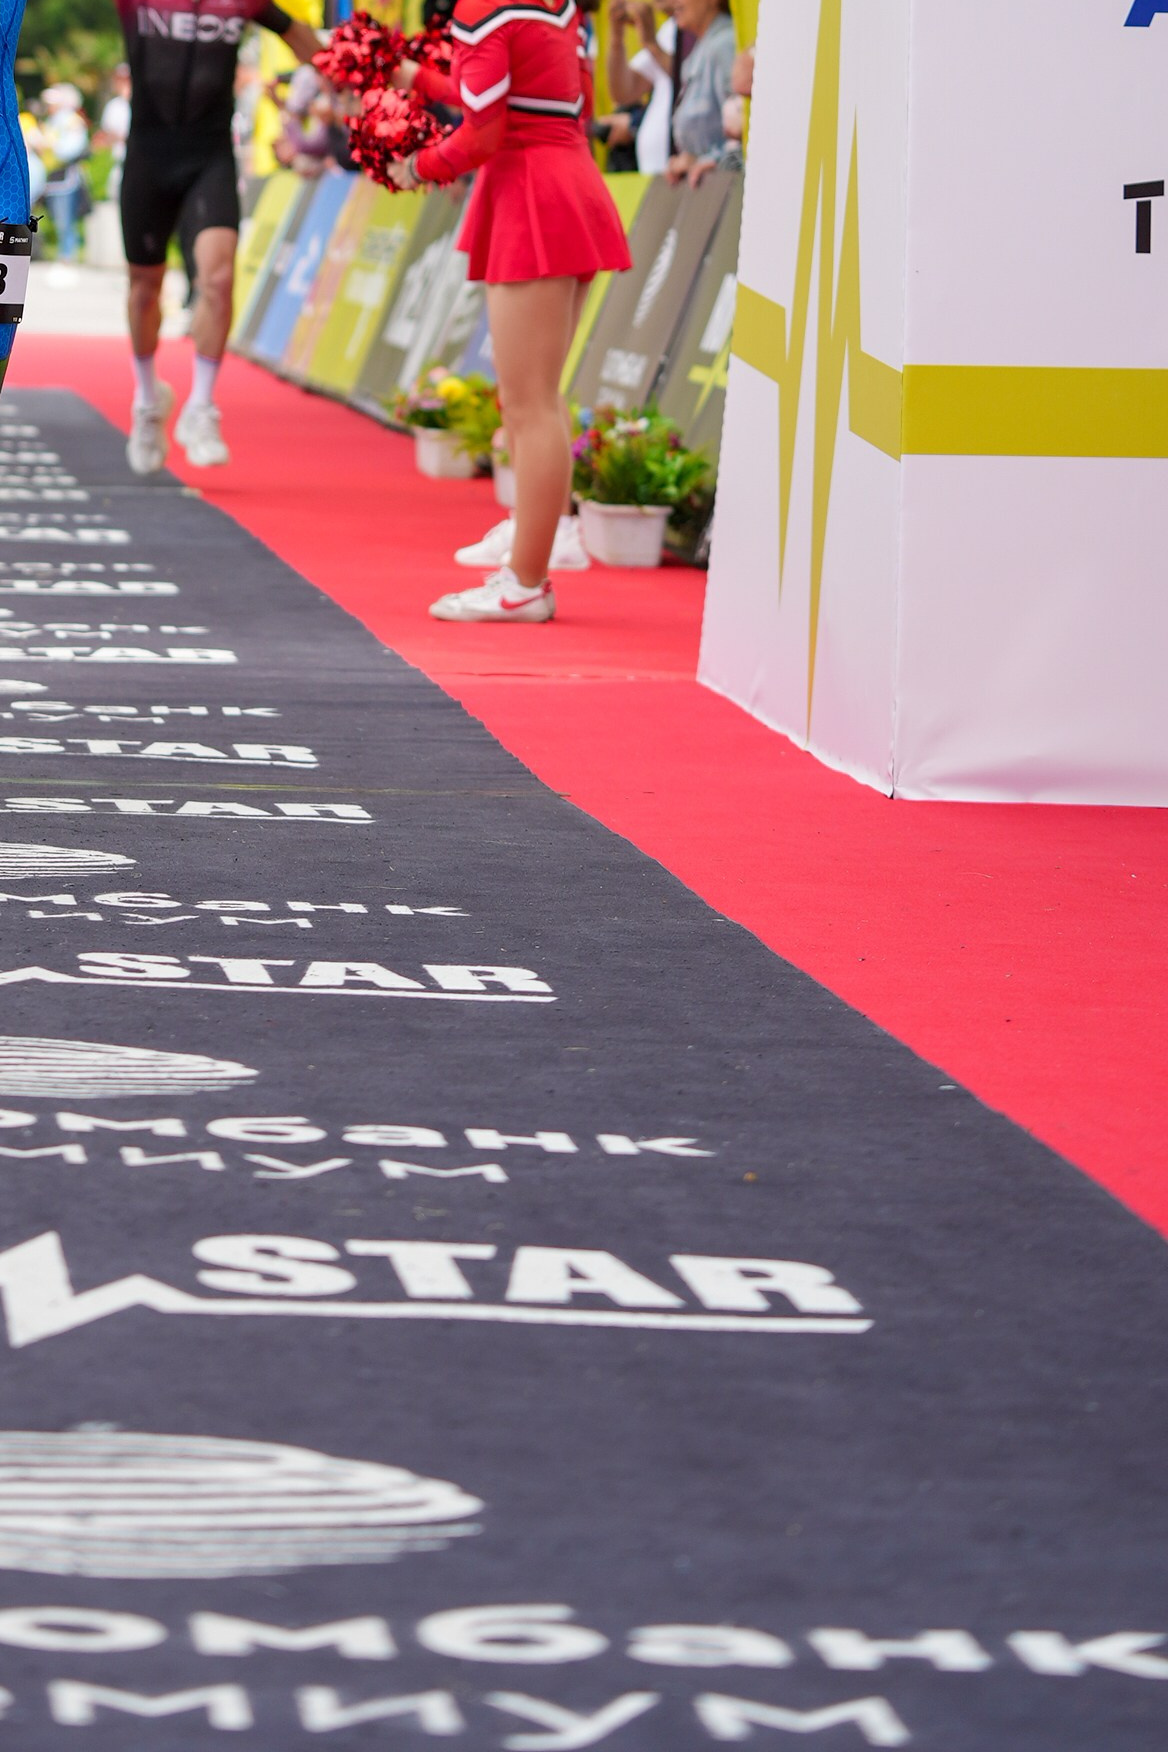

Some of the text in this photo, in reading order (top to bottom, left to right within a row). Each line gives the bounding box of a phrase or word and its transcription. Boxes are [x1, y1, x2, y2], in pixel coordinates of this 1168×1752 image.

[137, 6, 245, 45] INEOS
[4, 797, 372, 820] STAR
[77, 952, 553, 993] STAR
[192, 1234, 862, 1314] STAR
